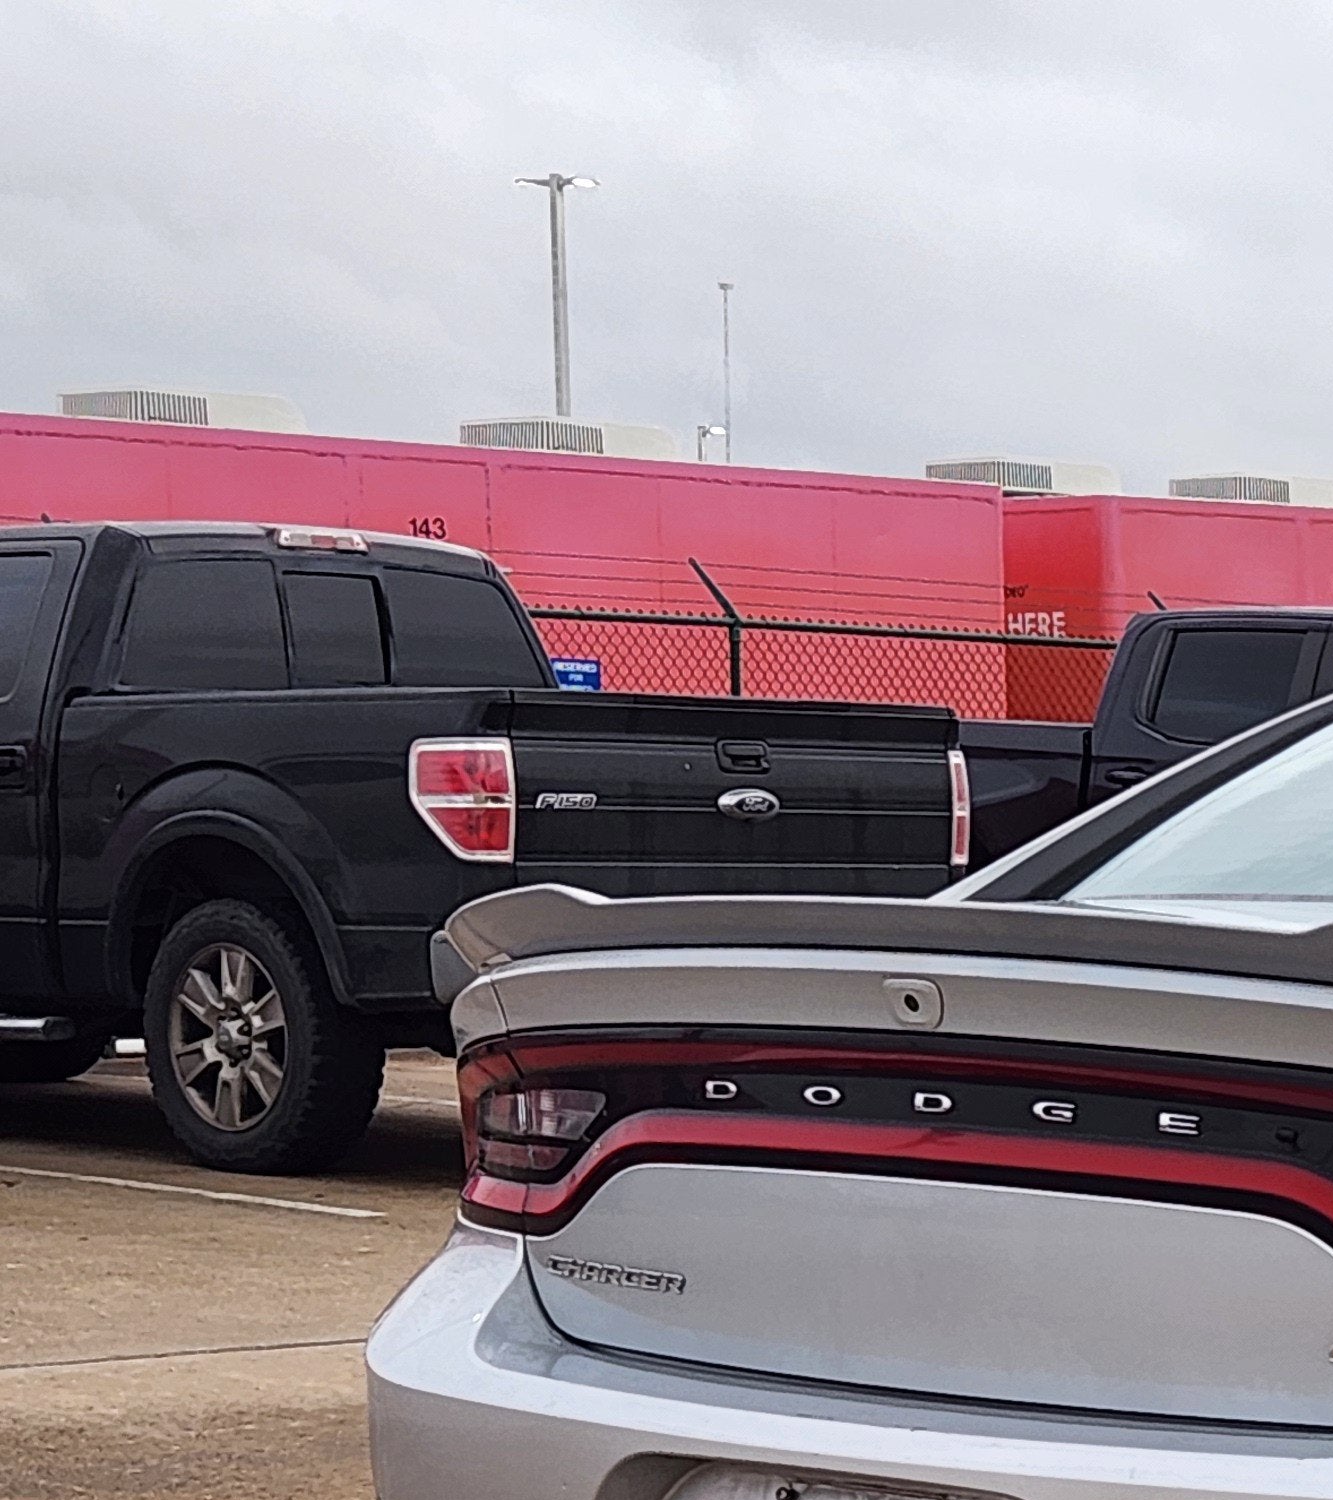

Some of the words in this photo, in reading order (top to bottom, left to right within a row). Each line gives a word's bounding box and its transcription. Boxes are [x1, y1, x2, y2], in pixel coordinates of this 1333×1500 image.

[408, 516, 447, 540] 143
[1006, 610, 1067, 638] HERE
[742, 796, 770, 812] Ford
[704, 1078, 1201, 1135] DODGE
[546, 1253, 686, 1295] CHARGER
